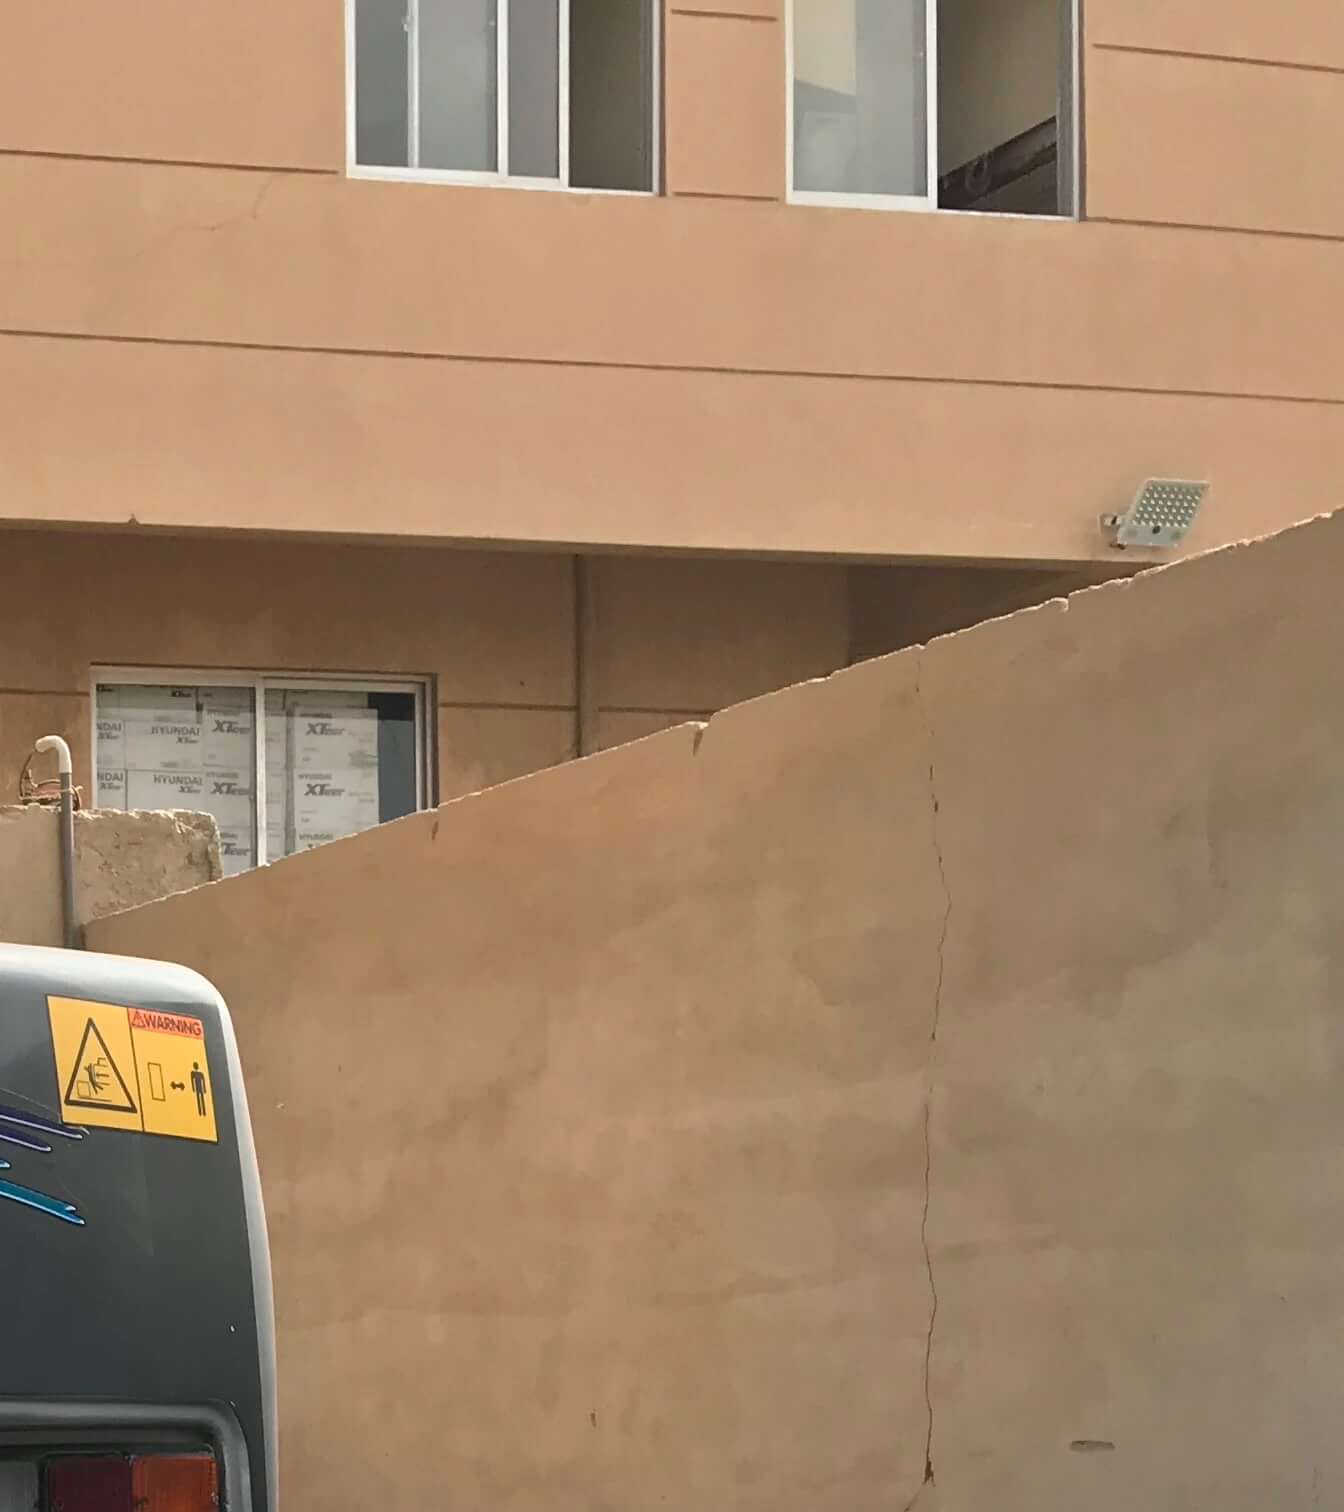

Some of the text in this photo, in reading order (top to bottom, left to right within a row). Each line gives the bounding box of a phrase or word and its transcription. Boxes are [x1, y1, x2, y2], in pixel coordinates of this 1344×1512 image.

[151, 725, 200, 737] HYUNDAI
[153, 774, 203, 786] HYUNDAI
[143, 1012, 202, 1036] WARNING
